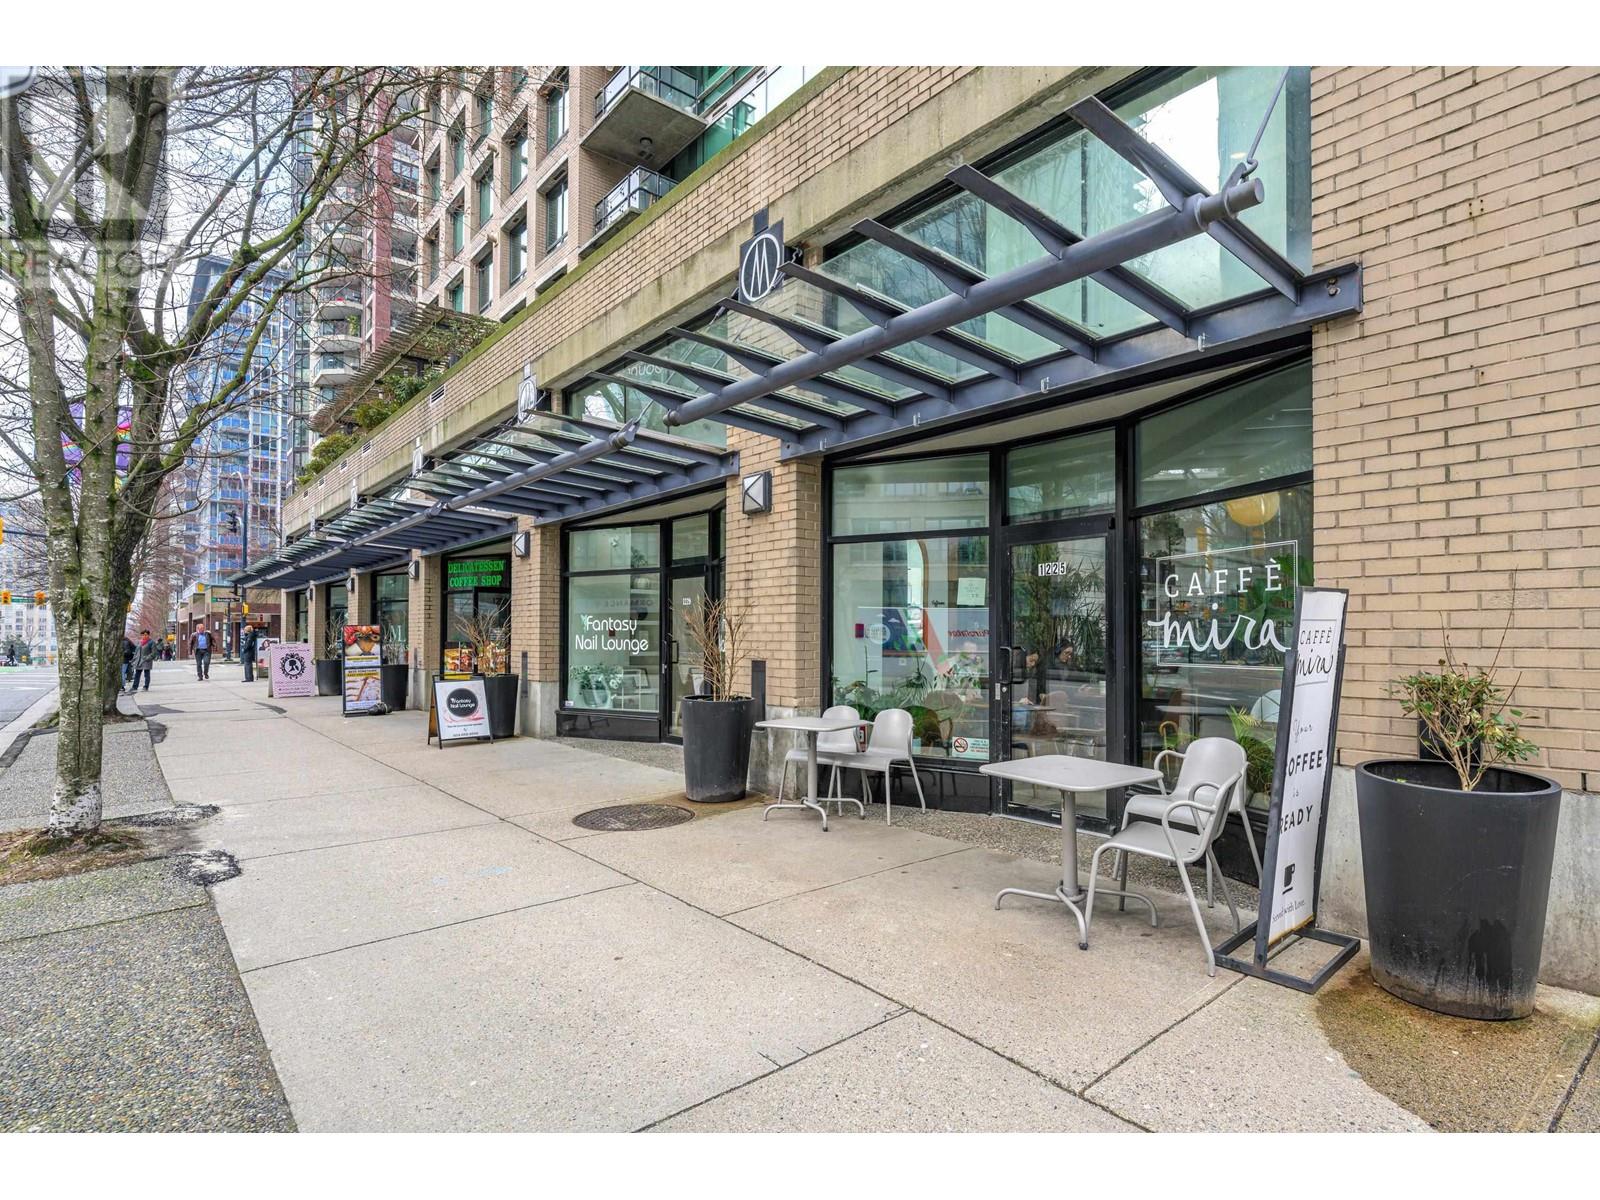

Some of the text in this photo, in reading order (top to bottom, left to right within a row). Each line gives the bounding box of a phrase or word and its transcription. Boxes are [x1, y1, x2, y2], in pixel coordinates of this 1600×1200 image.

[448, 560, 505, 574] DELICATESSEN
[1038, 562, 1066, 576] 1225
[449, 575, 502, 587] COFFEE SHOP
[1164, 558, 1282, 597] CAFFÈ
[586, 615, 638, 635] Fantasy
[1147, 602, 1292, 652] mira
[575, 634, 649, 654] Nail Lounge
[1288, 749, 1323, 777] OFFEE
